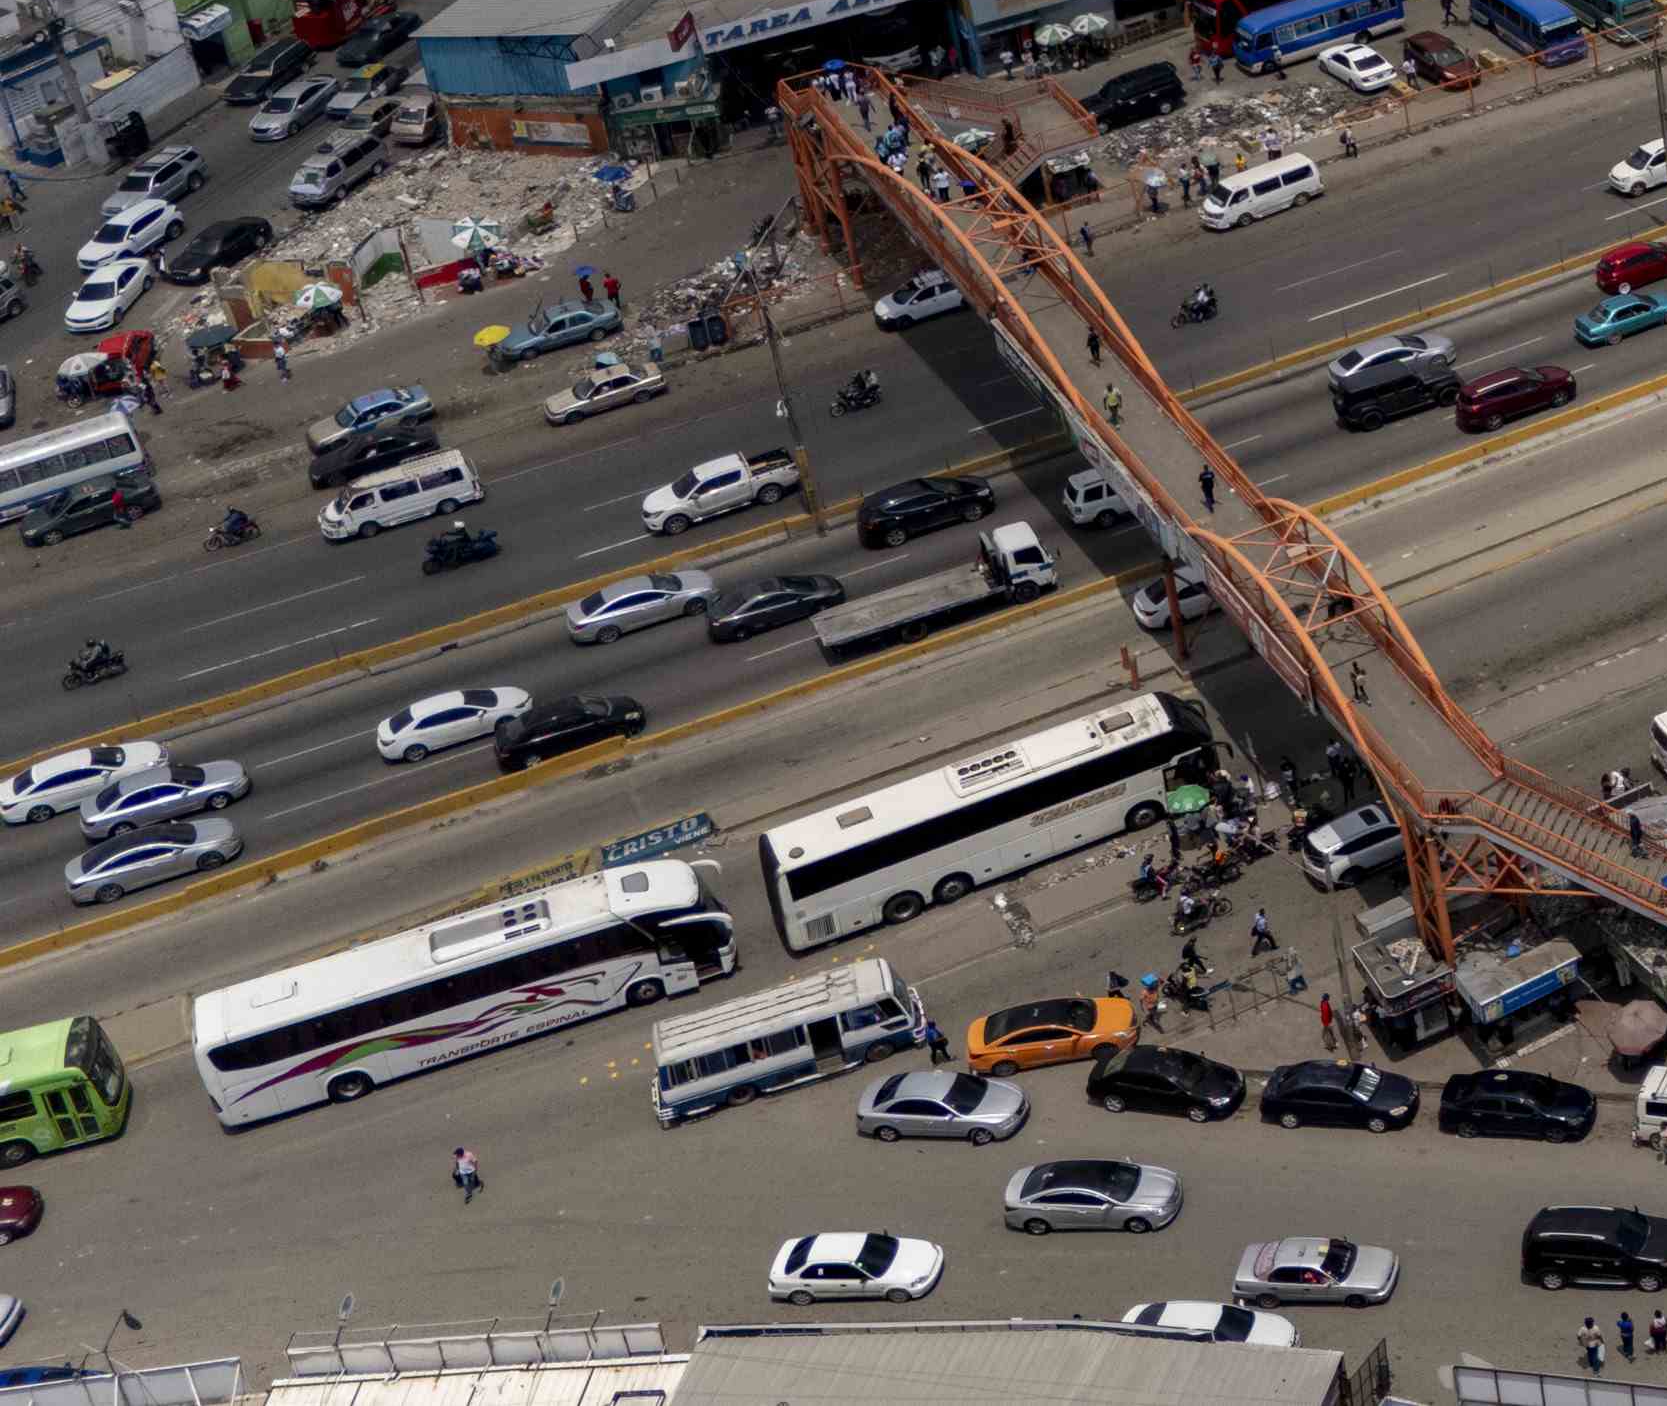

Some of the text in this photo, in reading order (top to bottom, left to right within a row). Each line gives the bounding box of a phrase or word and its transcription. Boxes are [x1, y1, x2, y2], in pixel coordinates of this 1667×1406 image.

[609, 817, 699, 862] CRISTO
[418, 1009, 590, 1067] TRANSPORTE ESPINAL
